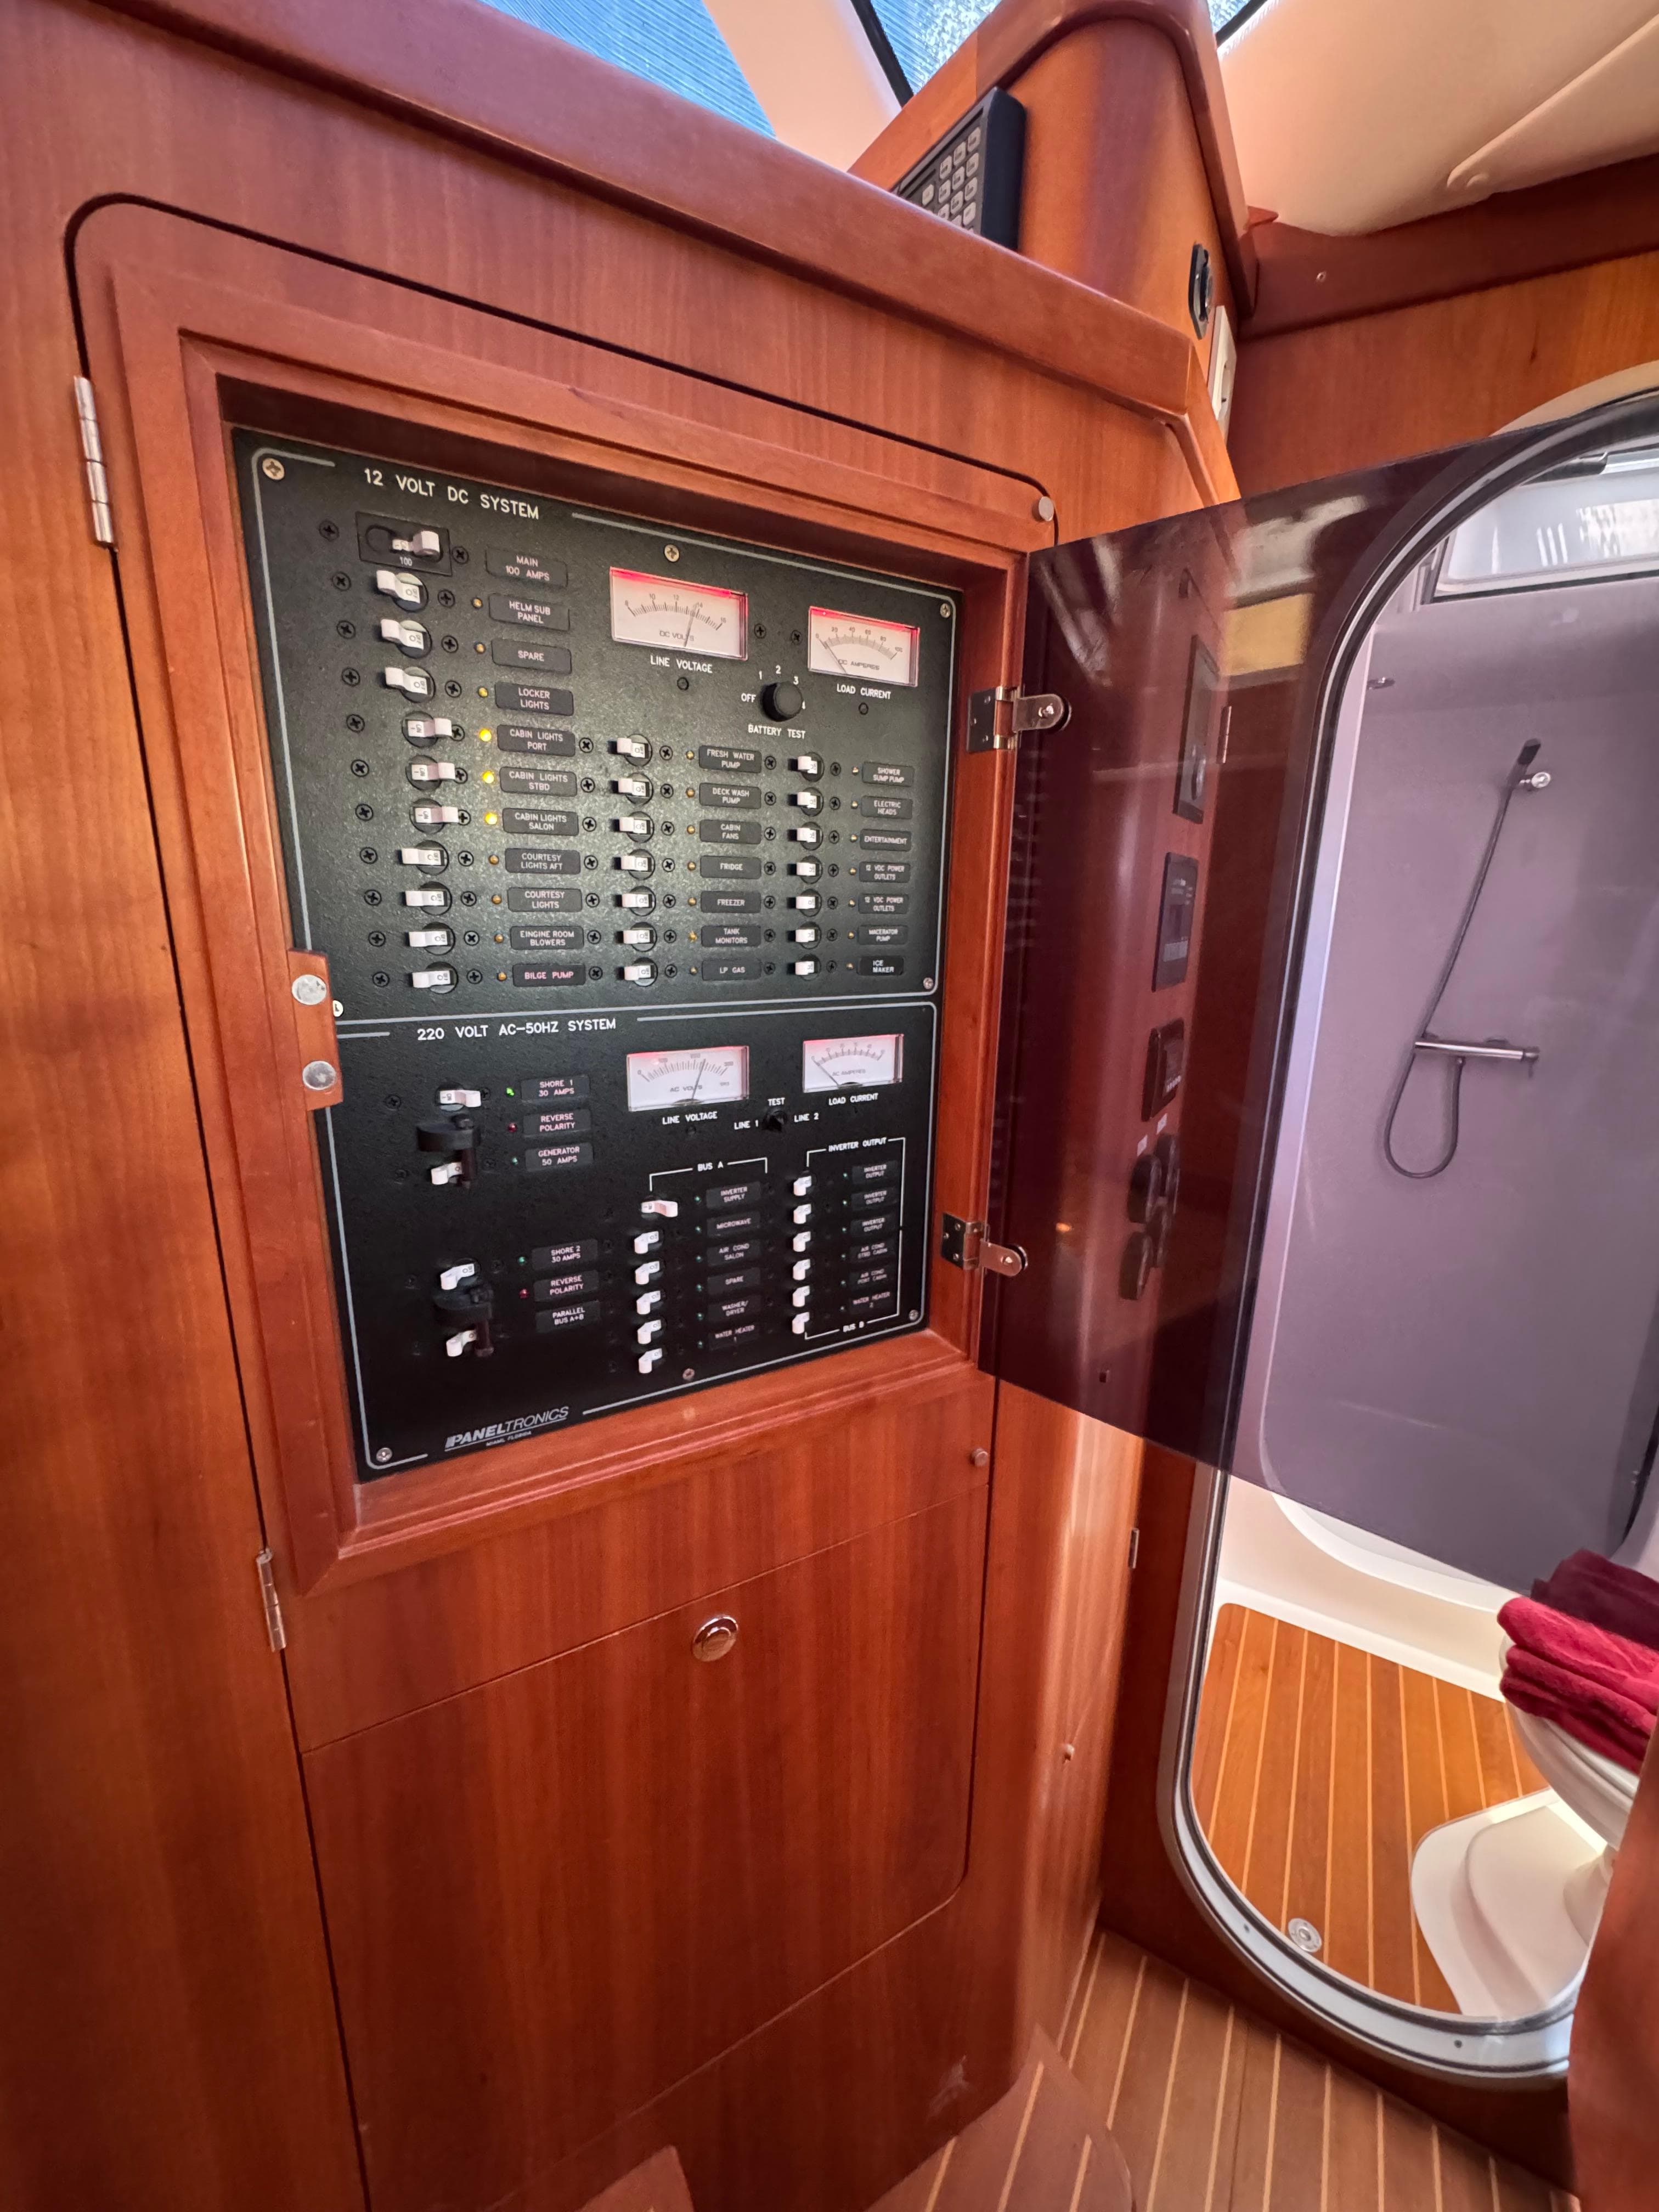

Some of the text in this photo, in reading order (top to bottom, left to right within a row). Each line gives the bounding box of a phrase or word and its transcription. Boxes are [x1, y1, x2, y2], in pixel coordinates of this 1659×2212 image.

[365, 469, 539, 520] 12 VOLT DC SYSTEM
[399, 557, 412, 566] 100
[517, 555, 538, 567] MAIN
[506, 566, 550, 581] 100 AMPS
[510, 601, 550, 615] HELM SUB
[518, 612, 544, 624] PANEL
[518, 651, 544, 662] SPARE
[650, 655, 713, 673] LINE VOLTAGE
[775, 664, 781, 674] 2
[759, 670, 763, 680] 1
[793, 676, 799, 685] 3
[518, 688, 550, 698] LOCKER
[837, 683, 891, 699] LOAD CURRENT
[741, 693, 756, 702] OFF
[520, 699, 549, 710] LIGHTS
[510, 729, 563, 742] CABIN LIGHTS
[748, 724, 806, 739] BATTERY TEST
[527, 741, 547, 751] PORT
[707, 749, 754, 761] FRESH WATER
[509, 771, 568, 782] CABIN LIGHTS
[529, 782, 550, 791] STBD
[713, 787, 730, 795] DECK
[874, 800, 901, 809] ELECTRIC
[515, 812, 538, 821] CABIN
[529, 822, 554, 831] SALON
[864, 836, 907, 845] ENTERTAINMENT
[522, 853, 561, 861] COURTESY
[521, 861, 548, 870] LIGHTS
[720, 862, 743, 871] FRIDGE
[525, 890, 565, 899] COURTESY
[532, 901, 560, 909] LIGHTS
[524, 971, 574, 980] BILGE PUMP
[417, 1018, 616, 1041] 220 VOLT AC-50HZ SYSTEM
[540, 1080, 565, 1088] SHORE
[554, 1088, 575, 1096] AMPS
[768, 1097, 785, 1106] TEST
[828, 1093, 878, 1105] LOAD CURRENT
[540, 1113, 574, 1122] REVERSE
[662, 1111, 718, 1125] LINE VOLTAGE
[794, 1113, 810, 1122] LINE
[540, 1122, 575, 1132] POLARITY
[734, 1120, 751, 1130] LINE
[828, 1137, 887, 1152] INVERTER OUTPUT
[538, 1147, 580, 1157] GENERATOR
[557, 1155, 578, 1164] AMPS
[698, 1163, 713, 1172] BUS
[864, 1164, 887, 1172] INVERTER
[720, 1186, 748, 1196] INVERTER
[864, 1190, 887, 1199] INVERTER
[724, 1194, 745, 1203] SUPPLY
[866, 1197, 884, 1205] OUTPUT
[716, 1218, 752, 1229] MICROWAVE
[862, 1217, 885, 1226] INVERTER
[864, 1223, 883, 1232] OUTPUT
[551, 1246, 574, 1256] SHORE
[733, 1243, 749, 1251] COND
[562, 1252, 581, 1261] AMPS
[724, 1252, 744, 1260] SALON
[551, 1275, 582, 1286] REVERSE
[725, 1276, 743, 1285] SPARE
[550, 1283, 584, 1295] POLARITY
[872, 1291, 890, 1300] HEATER
[552, 1307, 585, 1318] PARALLEL
[554, 1317, 568, 1325] BUS
[735, 1325, 755, 1334] HEATER
[843, 1323, 856, 1333] BUS
[445, 1406, 569, 1449] PANELTRONICS
